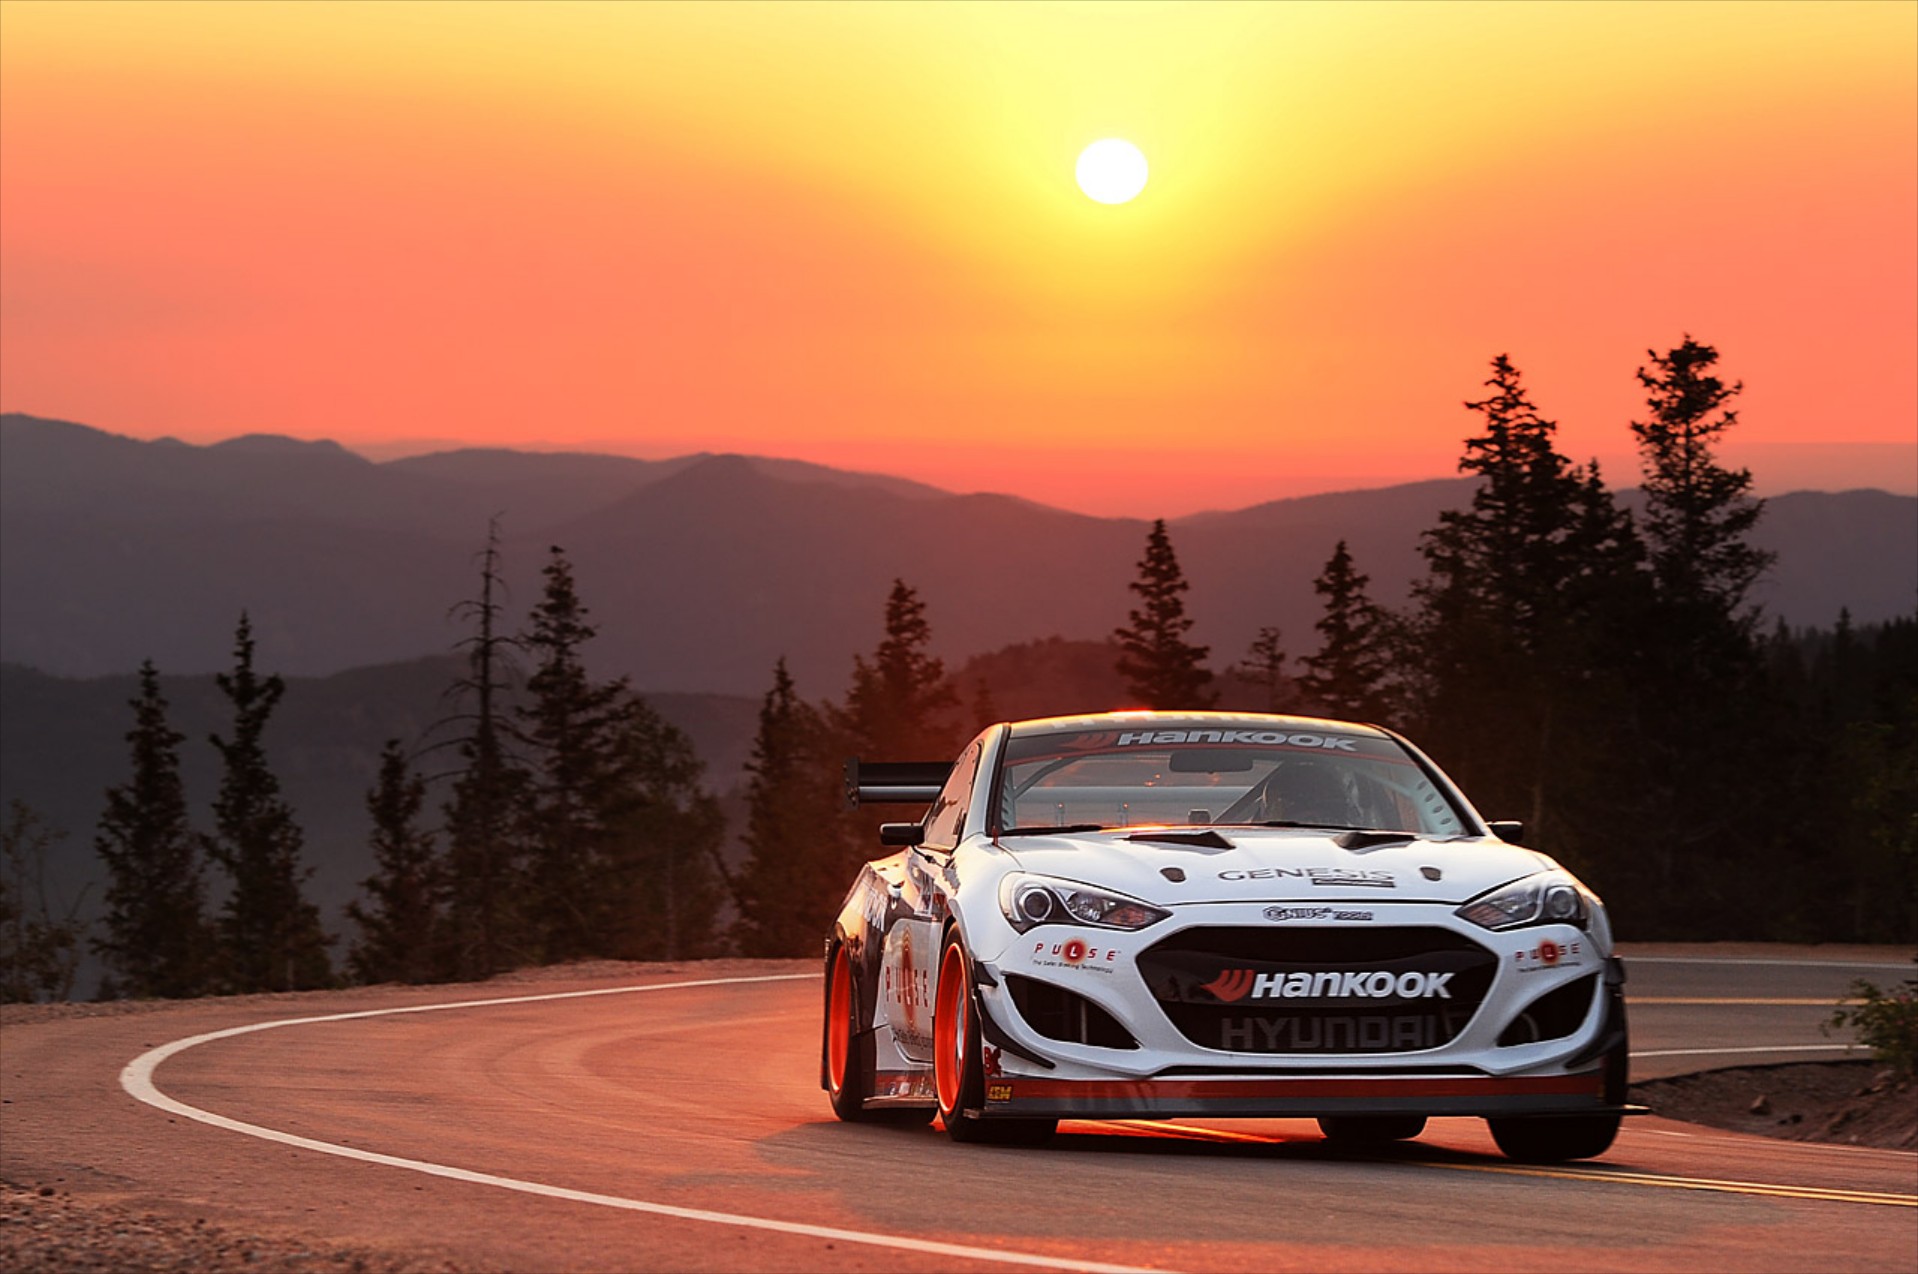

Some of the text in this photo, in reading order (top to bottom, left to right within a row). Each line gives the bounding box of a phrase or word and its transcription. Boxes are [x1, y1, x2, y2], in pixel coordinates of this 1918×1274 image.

[1218, 867, 1395, 881] GENESIS
[1034, 943, 1117, 961] PULSE
[1515, 943, 1580, 960] PULSE
[886, 966, 928, 1008] PULSE
[1221, 1014, 1437, 1049] HYUNDAI
